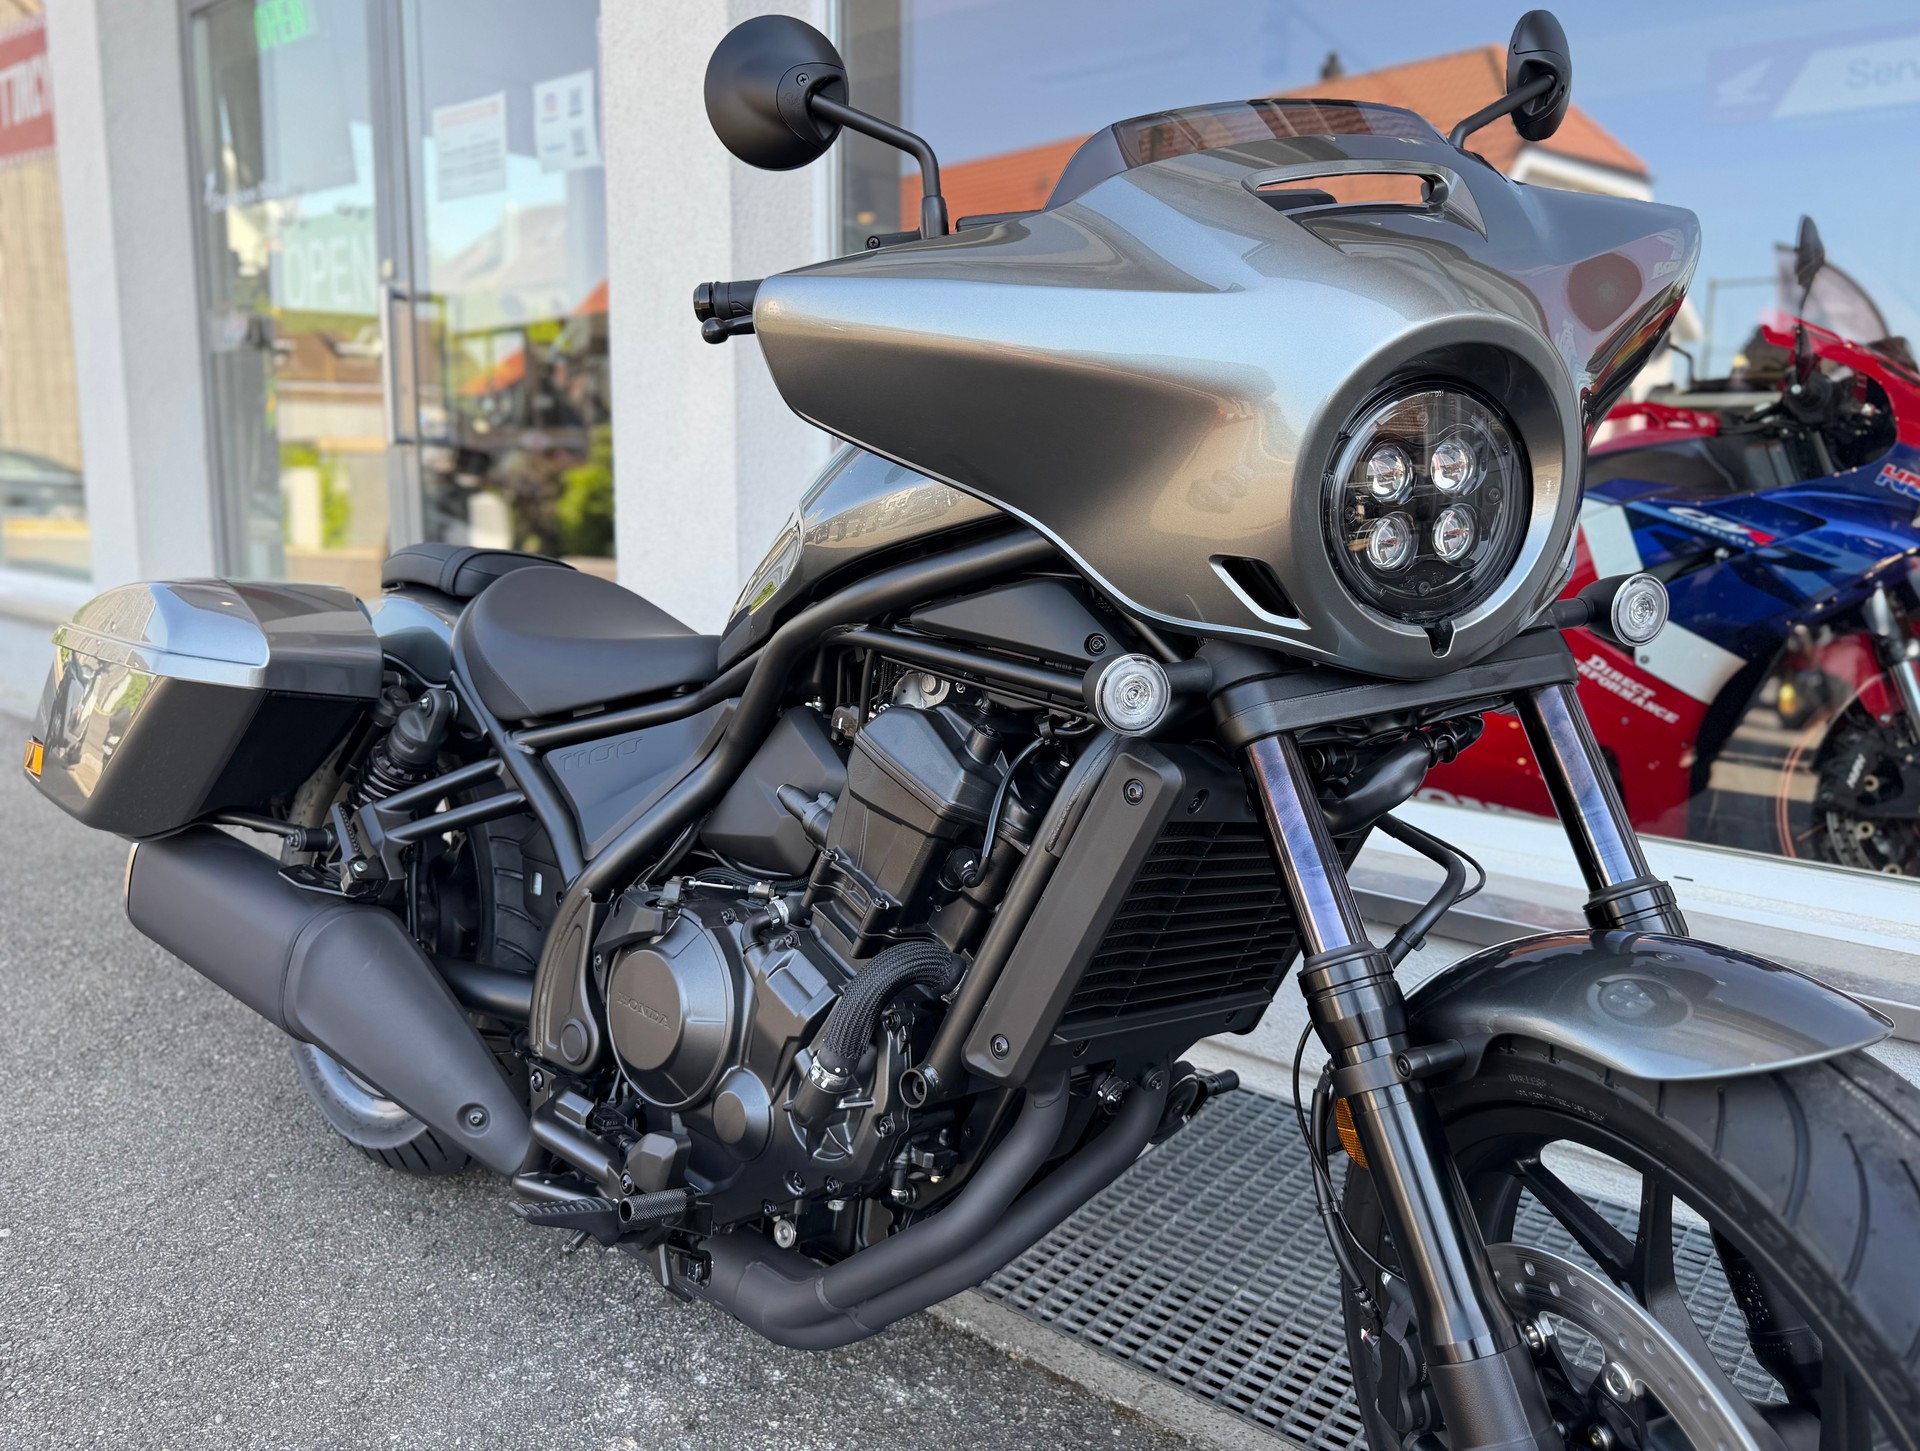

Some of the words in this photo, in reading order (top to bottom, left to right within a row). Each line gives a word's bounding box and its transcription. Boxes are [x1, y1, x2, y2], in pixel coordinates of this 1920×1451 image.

[283, 231, 377, 309] OPEN
[1574, 658, 1680, 724] RFORMANCE
[1587, 654, 1656, 699] DIRECT
[617, 991, 671, 1031] HONDA
